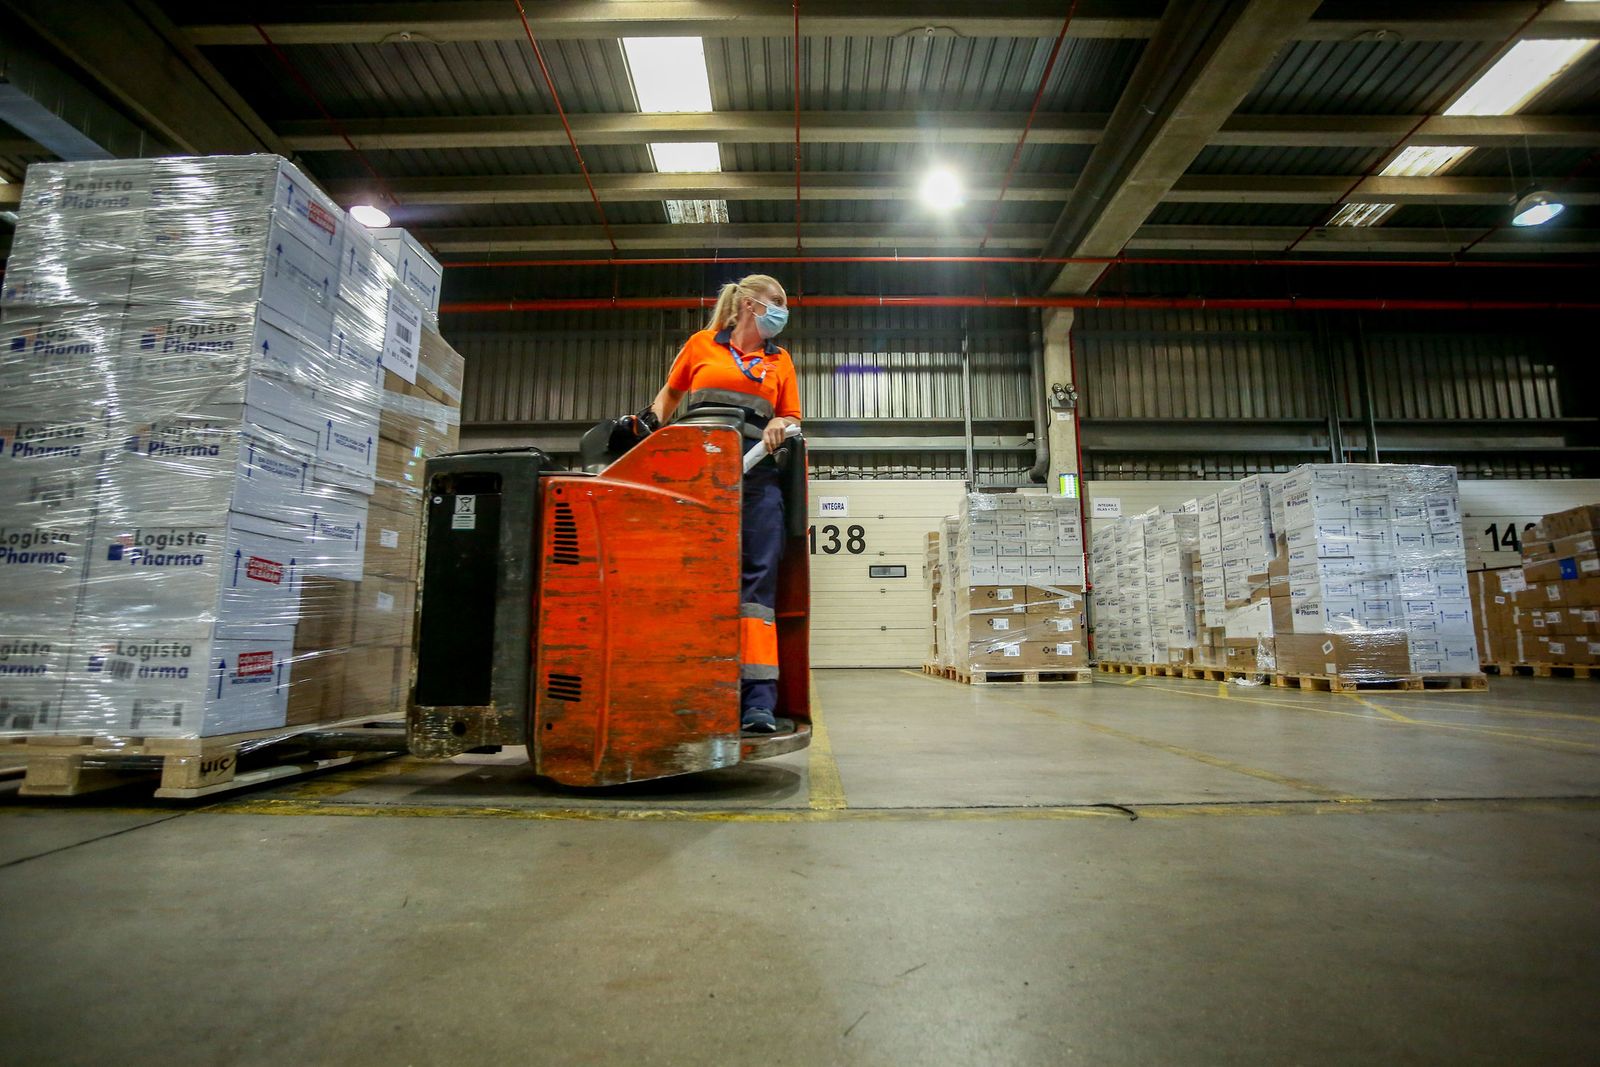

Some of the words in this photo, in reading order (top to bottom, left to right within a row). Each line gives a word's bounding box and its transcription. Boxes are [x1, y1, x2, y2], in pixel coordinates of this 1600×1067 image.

[166, 320, 237, 339] Logista
[163, 336, 234, 353] Pharma
[14, 422, 84, 443] Logista
[11, 442, 81, 458] Pharma
[147, 441, 219, 457] Pharma
[134, 529, 208, 550] Logista
[808, 525, 866, 555] 138
[1485, 523, 1536, 551] 14
[130, 548, 205, 566] Pharma
[116, 641, 192, 662] Logista
